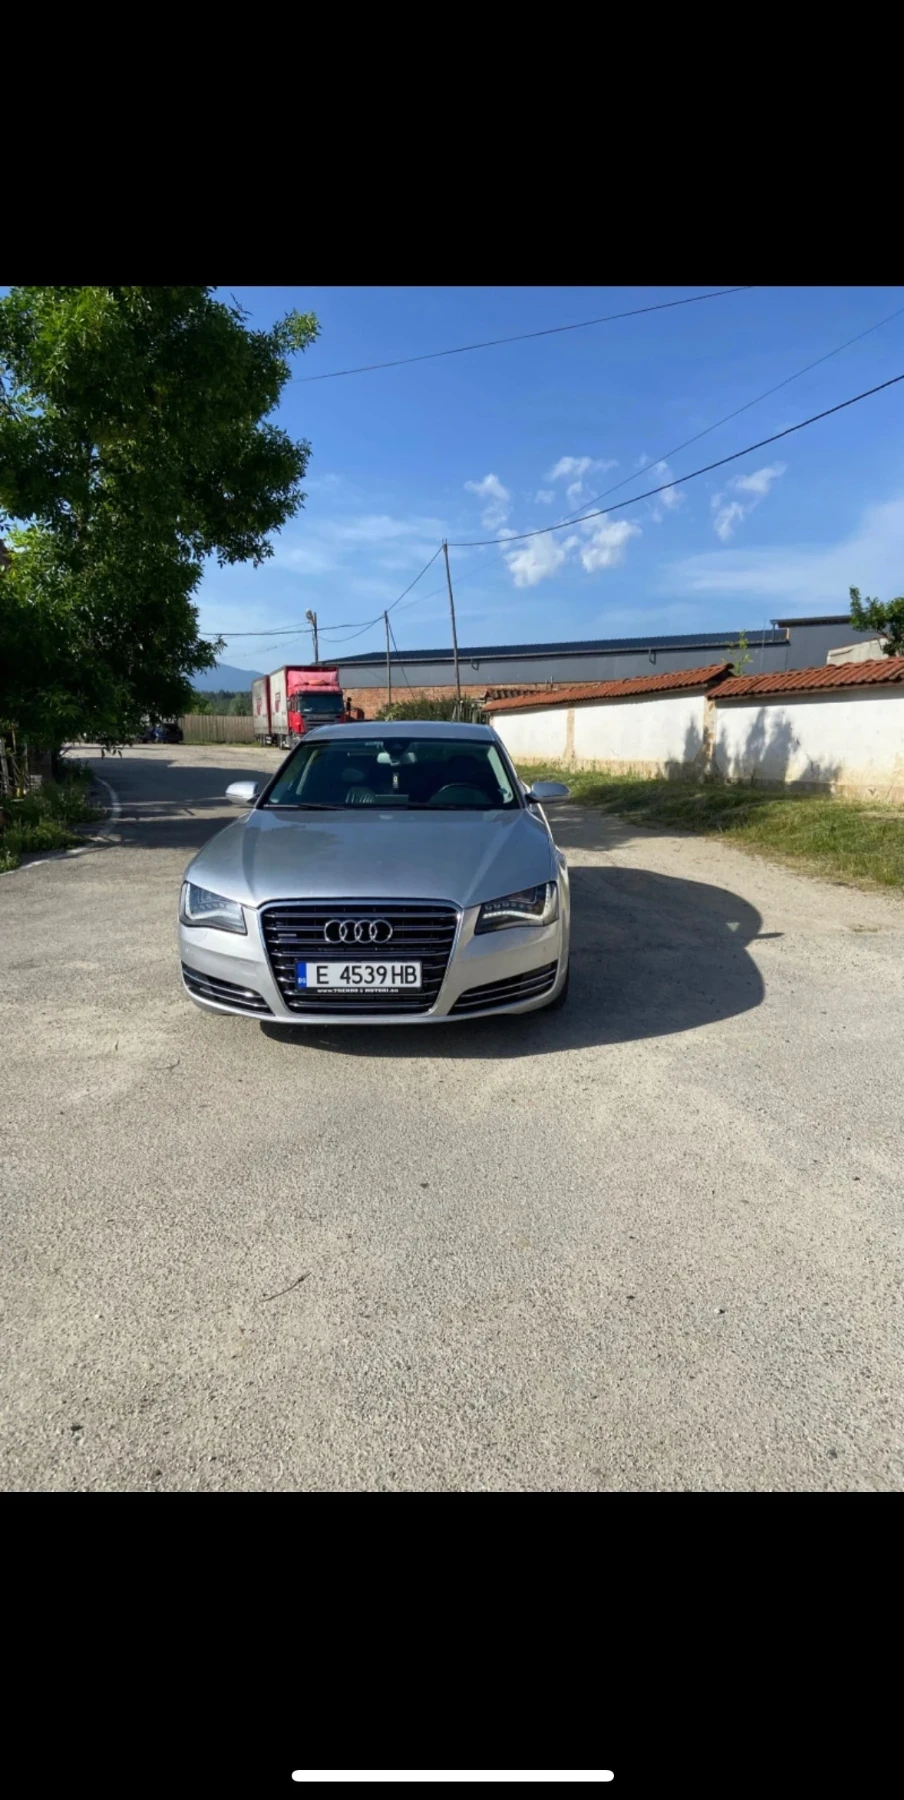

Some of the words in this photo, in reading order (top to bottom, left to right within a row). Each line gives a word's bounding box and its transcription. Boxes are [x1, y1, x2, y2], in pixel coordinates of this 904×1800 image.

[316, 965, 329, 984] E
[340, 965, 388, 984] 4539
[391, 965, 417, 984] HB
